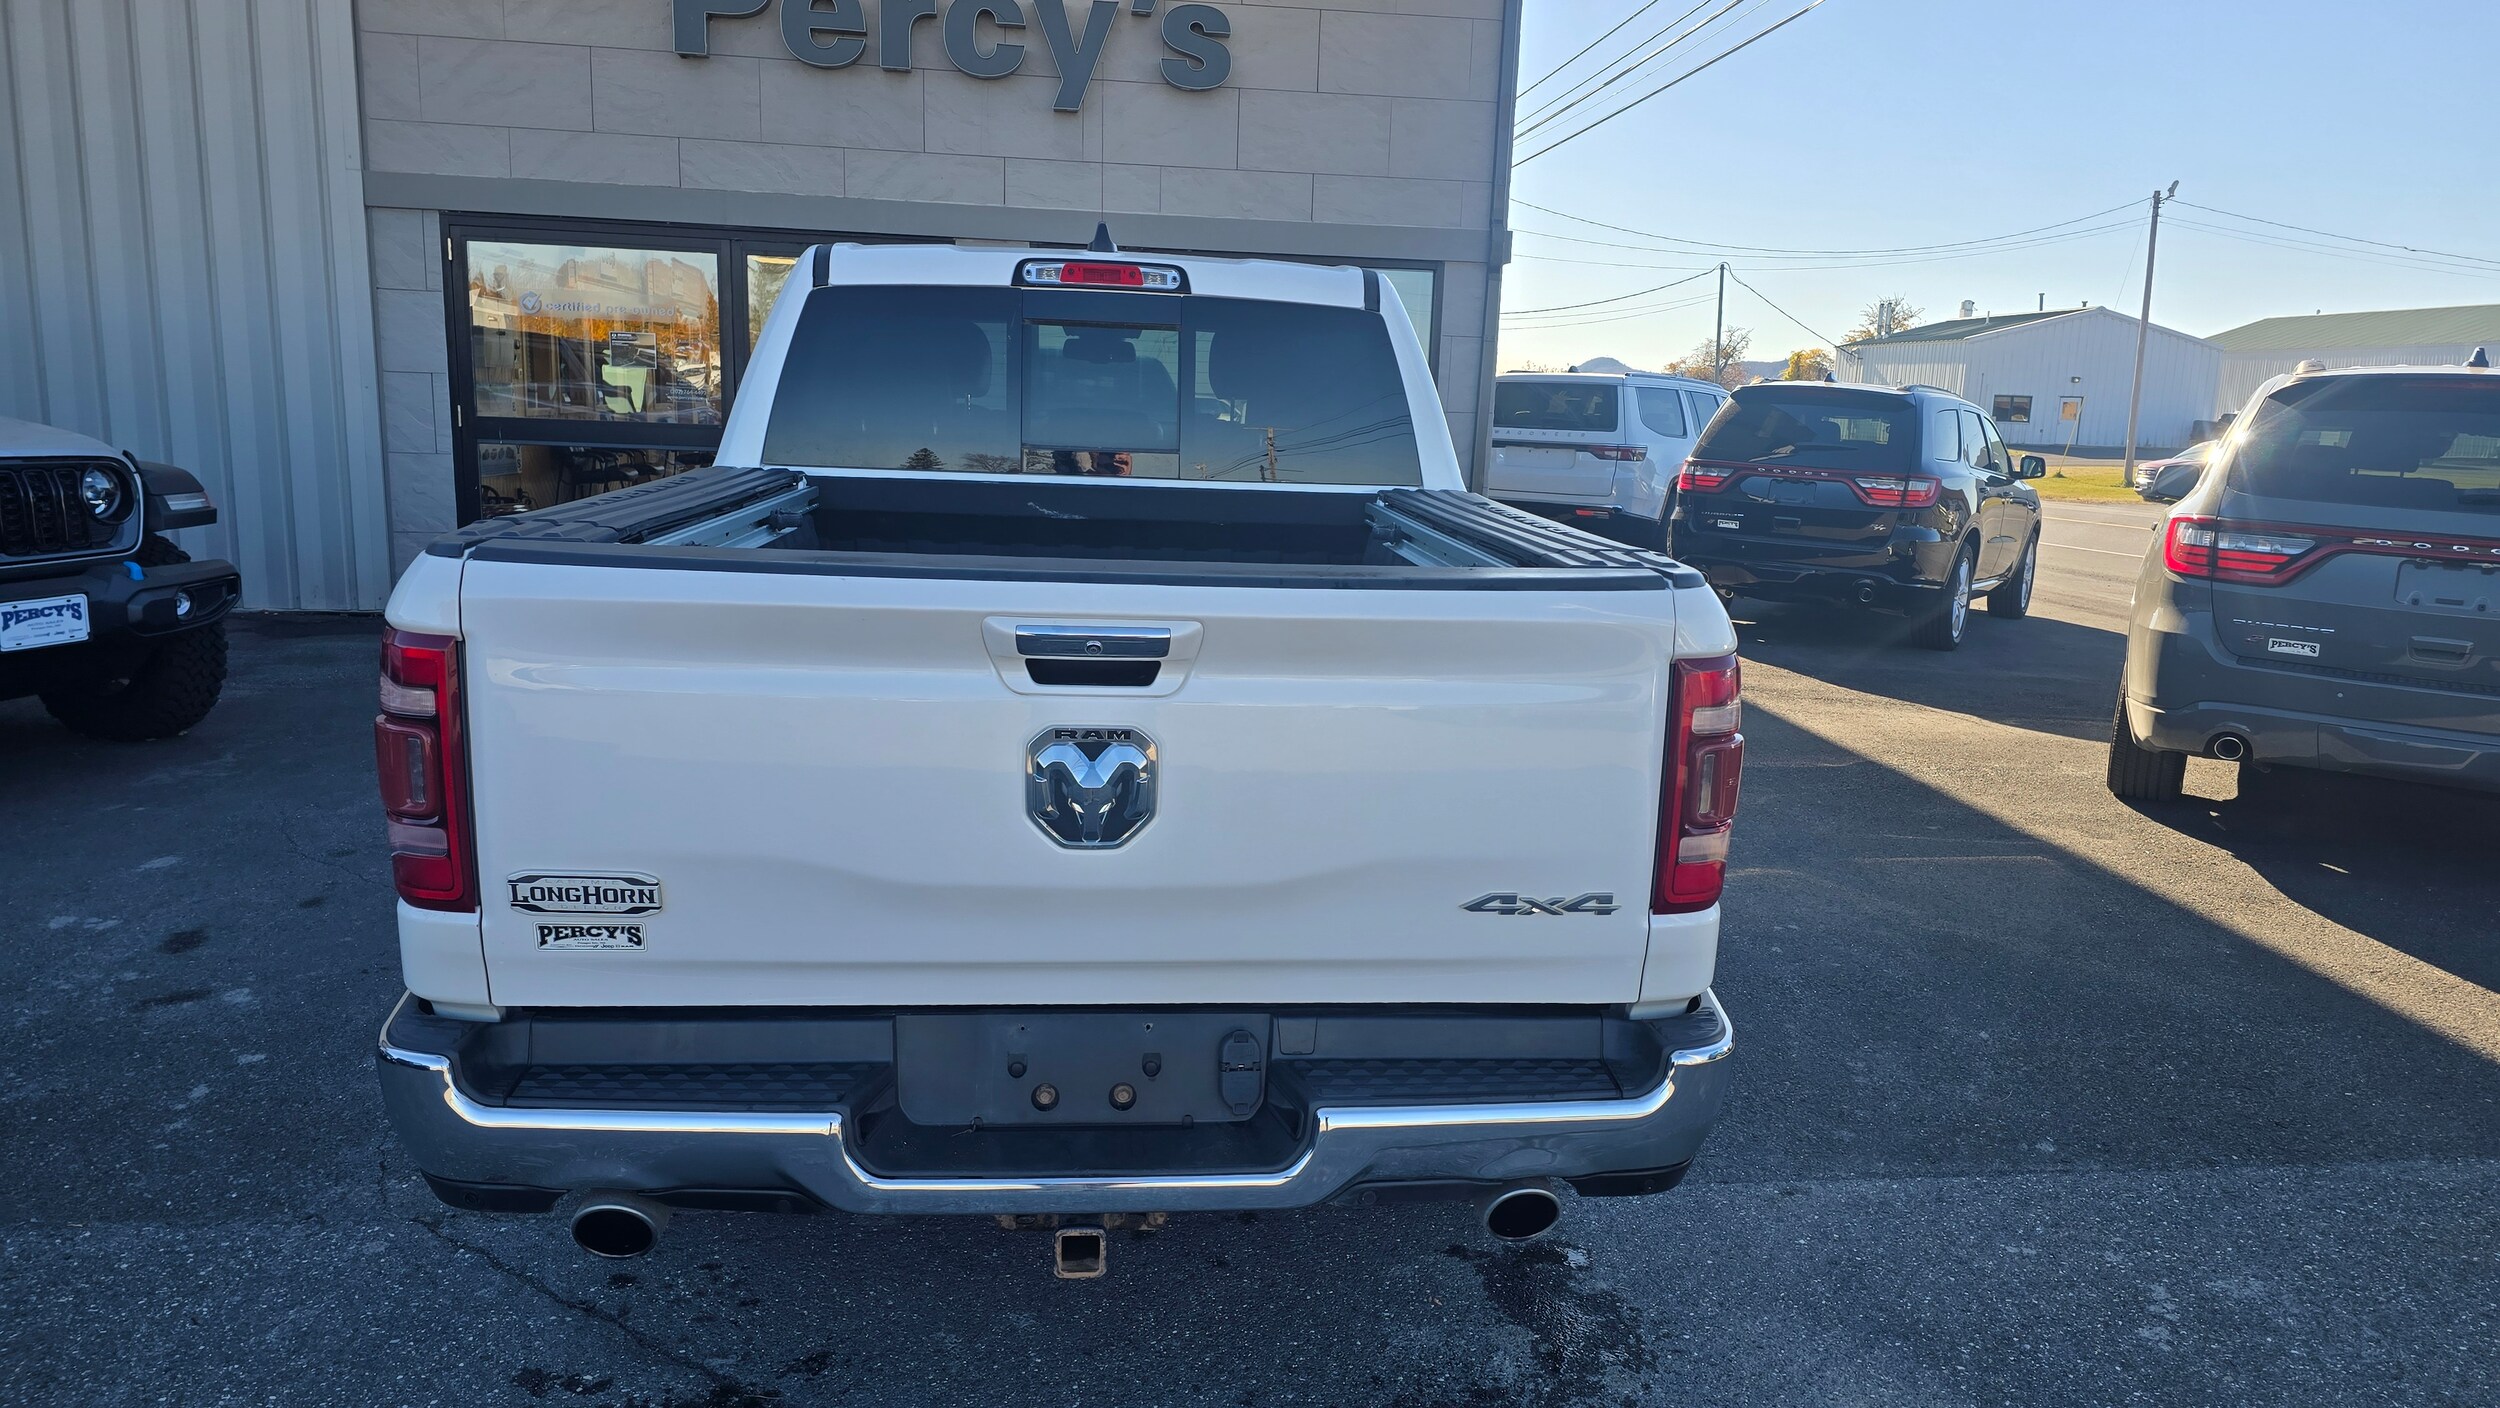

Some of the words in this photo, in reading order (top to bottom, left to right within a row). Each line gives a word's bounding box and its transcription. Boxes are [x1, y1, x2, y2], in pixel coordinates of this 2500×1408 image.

[545, 300, 601, 313] certified
[1494, 430, 1587, 438] WAGONEER
[1757, 467, 1829, 477] DODGE
[1, 602, 82, 632] PERCY'S
[2271, 640, 2317, 654] PERCY'S
[1054, 729, 1132, 740] RAM
[1458, 890, 1622, 916] 4x4
[538, 925, 643, 947] PERCY'S
